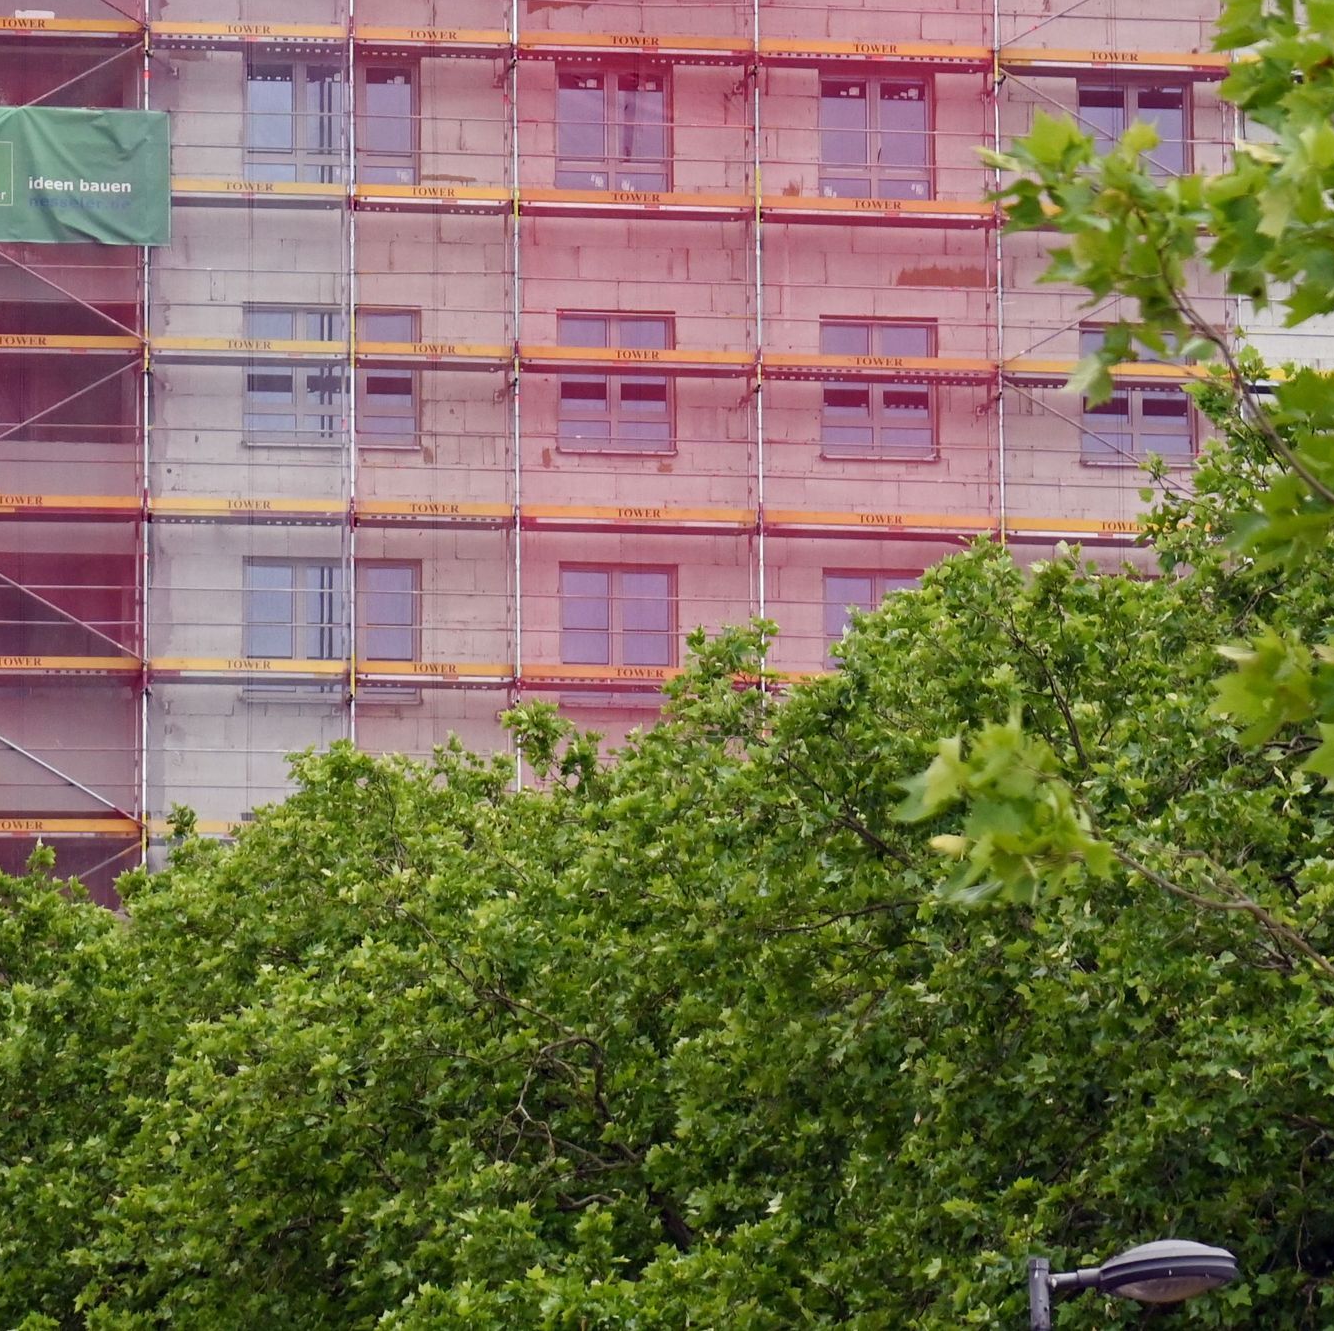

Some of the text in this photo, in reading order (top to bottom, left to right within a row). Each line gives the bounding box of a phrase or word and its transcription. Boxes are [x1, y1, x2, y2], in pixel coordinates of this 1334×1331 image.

[1, 19, 45, 29] TOWER
[226, 24, 271, 35] TOWER
[408, 30, 457, 40] TOWER
[610, 36, 659, 46] TOWER
[853, 44, 897, 54] TOWER
[1090, 51, 1138, 61] TOWER
[28, 176, 132, 193] ideen bauen
[224, 182, 273, 192] TOWER
[412, 187, 456, 197] TOWER
[611, 193, 660, 202] TOWER
[852, 200, 901, 210] TOWER
[227, 340, 271, 350] TOWER
[412, 344, 456, 354] TOWER
[615, 350, 659, 359] TOWER
[854, 357, 903, 367] TOWER
[227, 500, 271, 510] TOWER
[409, 503, 459, 513] TOWER
[617, 508, 660, 518] TOWER
[860, 515, 903, 524] TOWER
[227, 660, 271, 670] TOWER
[412, 663, 457, 673] TOWER
[614, 668, 664, 678] TOWER
